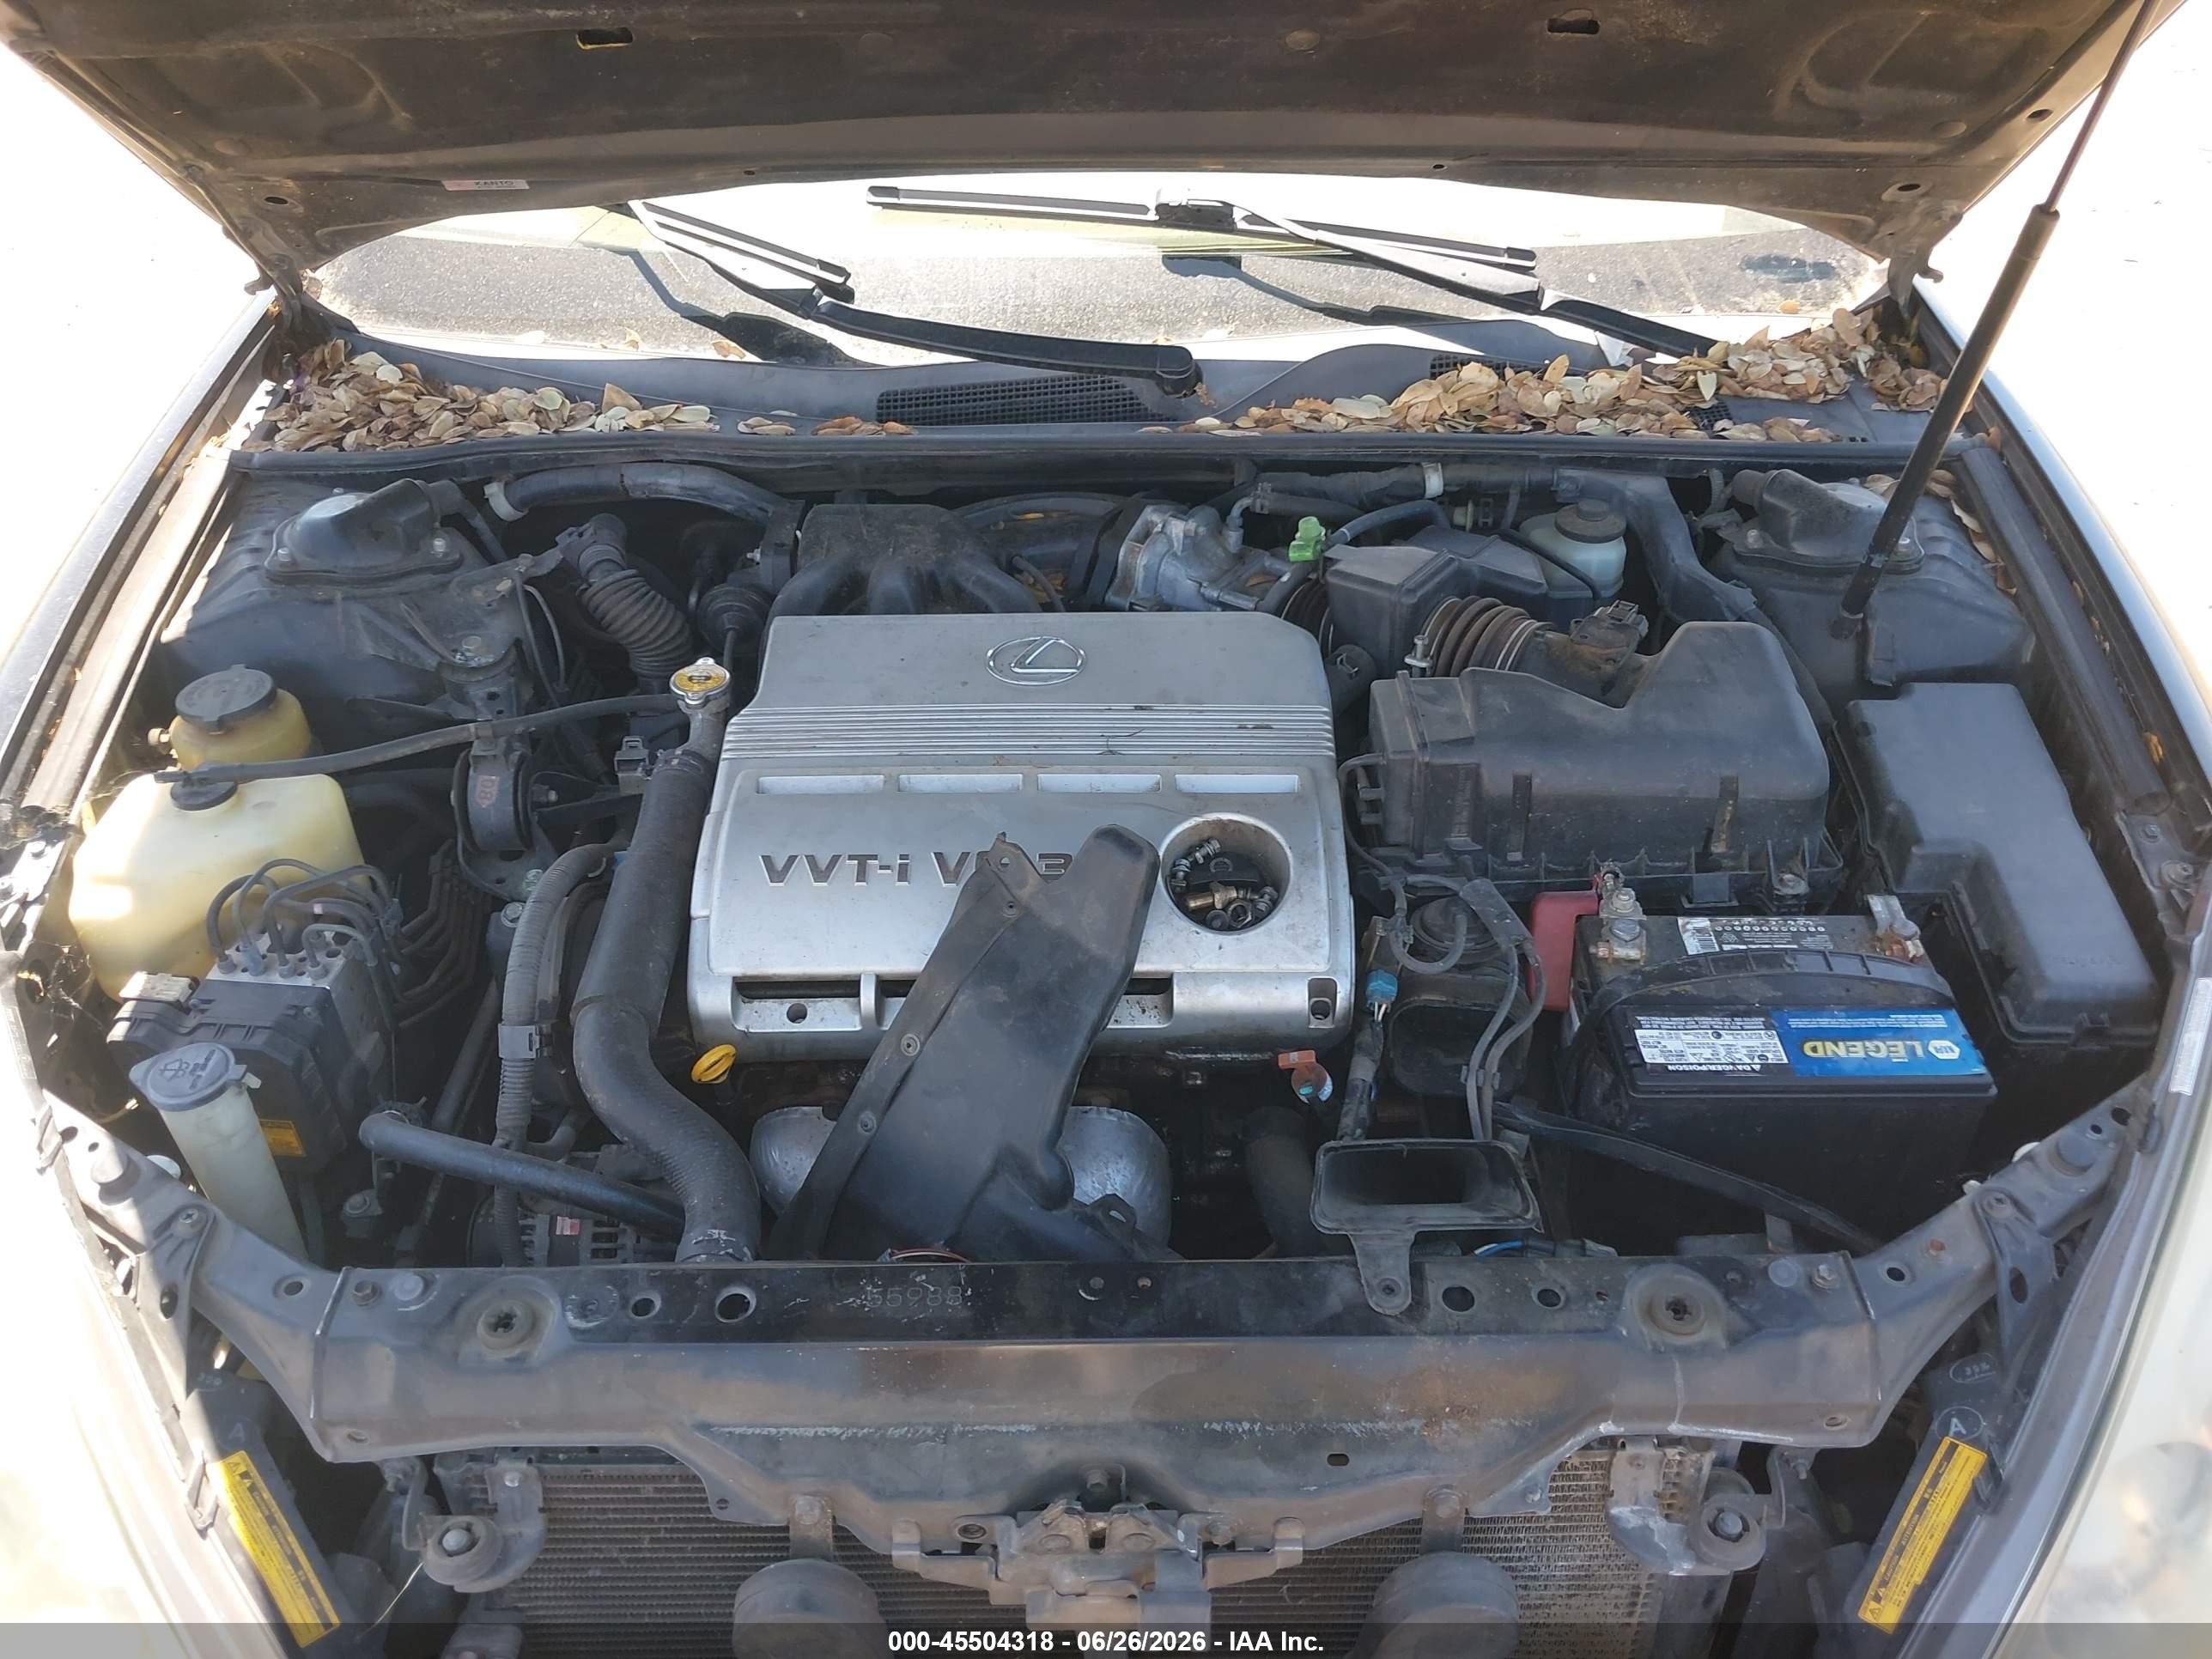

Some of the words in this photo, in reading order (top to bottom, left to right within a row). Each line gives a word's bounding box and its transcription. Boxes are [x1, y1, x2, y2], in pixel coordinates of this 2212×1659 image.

[759, 853, 910, 886] VVT-i
[1803, 1040, 1923, 1060] LEGEND
[1948, 1416, 1967, 1437] A
